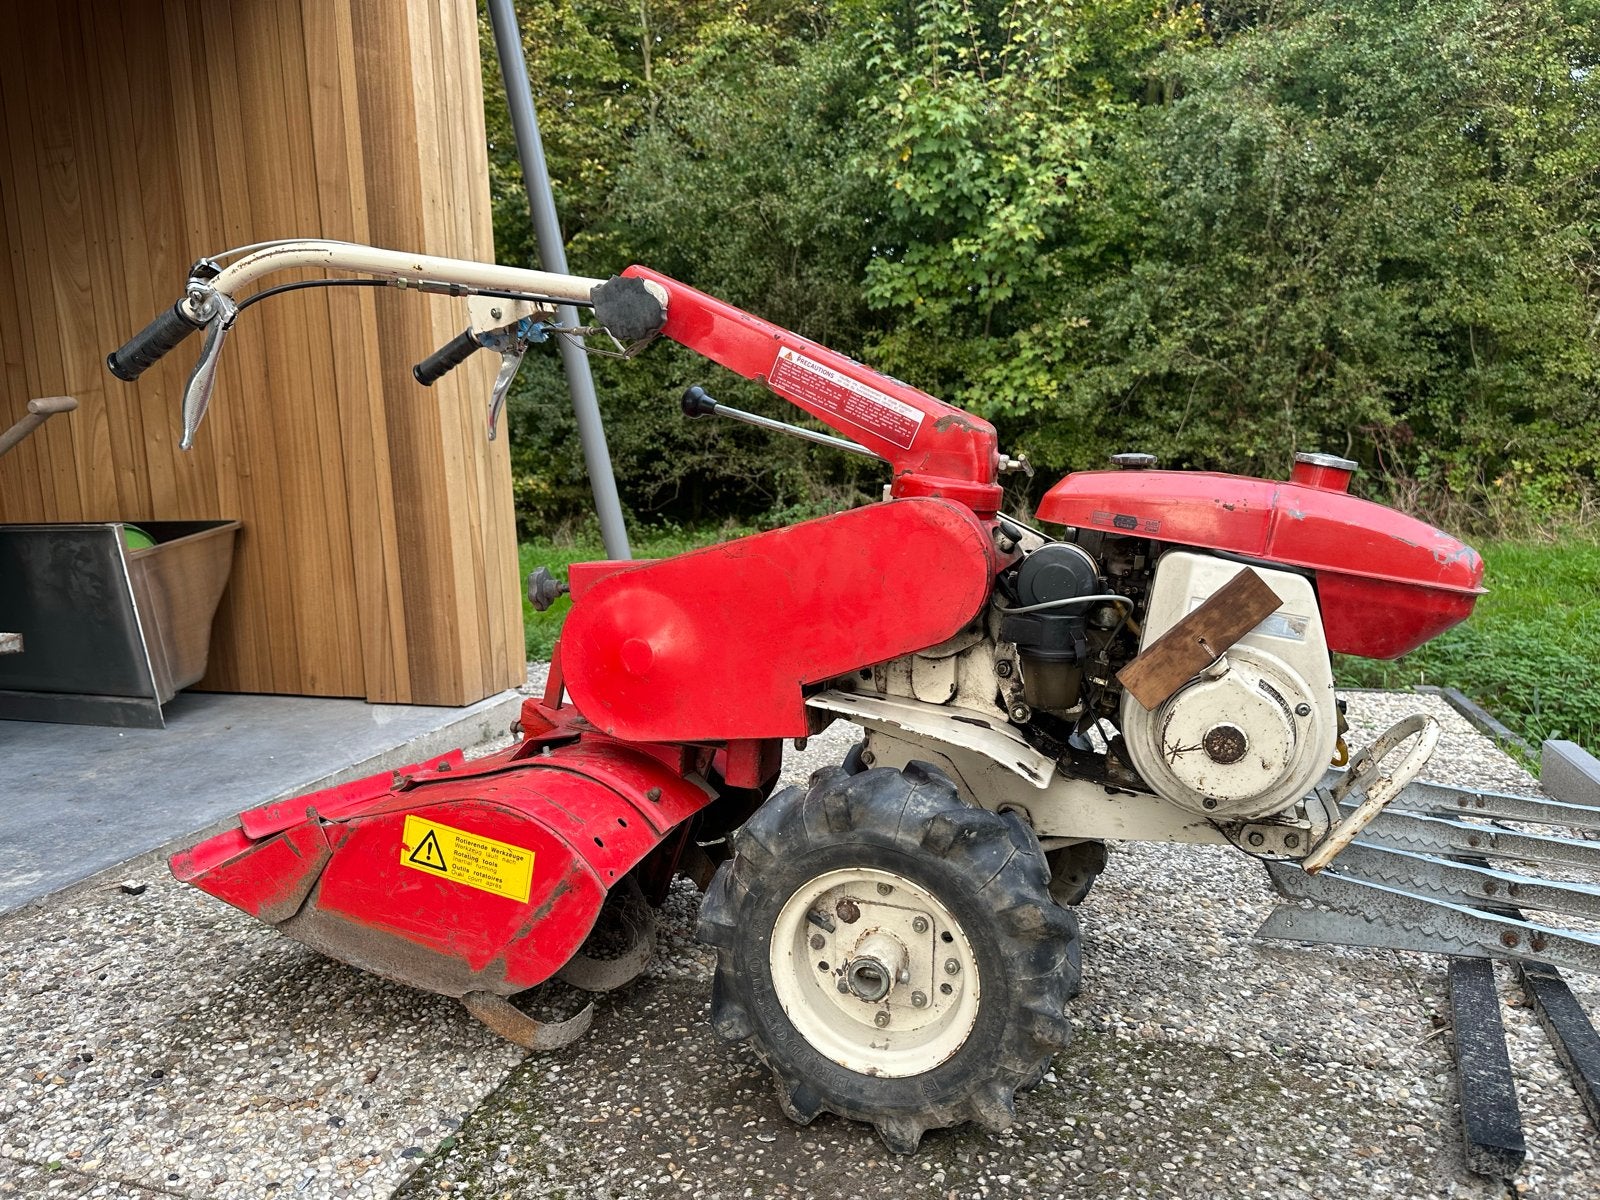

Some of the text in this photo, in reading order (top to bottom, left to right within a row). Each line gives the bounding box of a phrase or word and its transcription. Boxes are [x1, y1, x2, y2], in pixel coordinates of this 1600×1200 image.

[796, 355, 835, 379] PRECAUTIONS
[453, 849, 498, 868] Rotating tools
[455, 836, 524, 861] Rotierende Werkzeuge
[452, 863, 503, 883] Outils rotatoires
